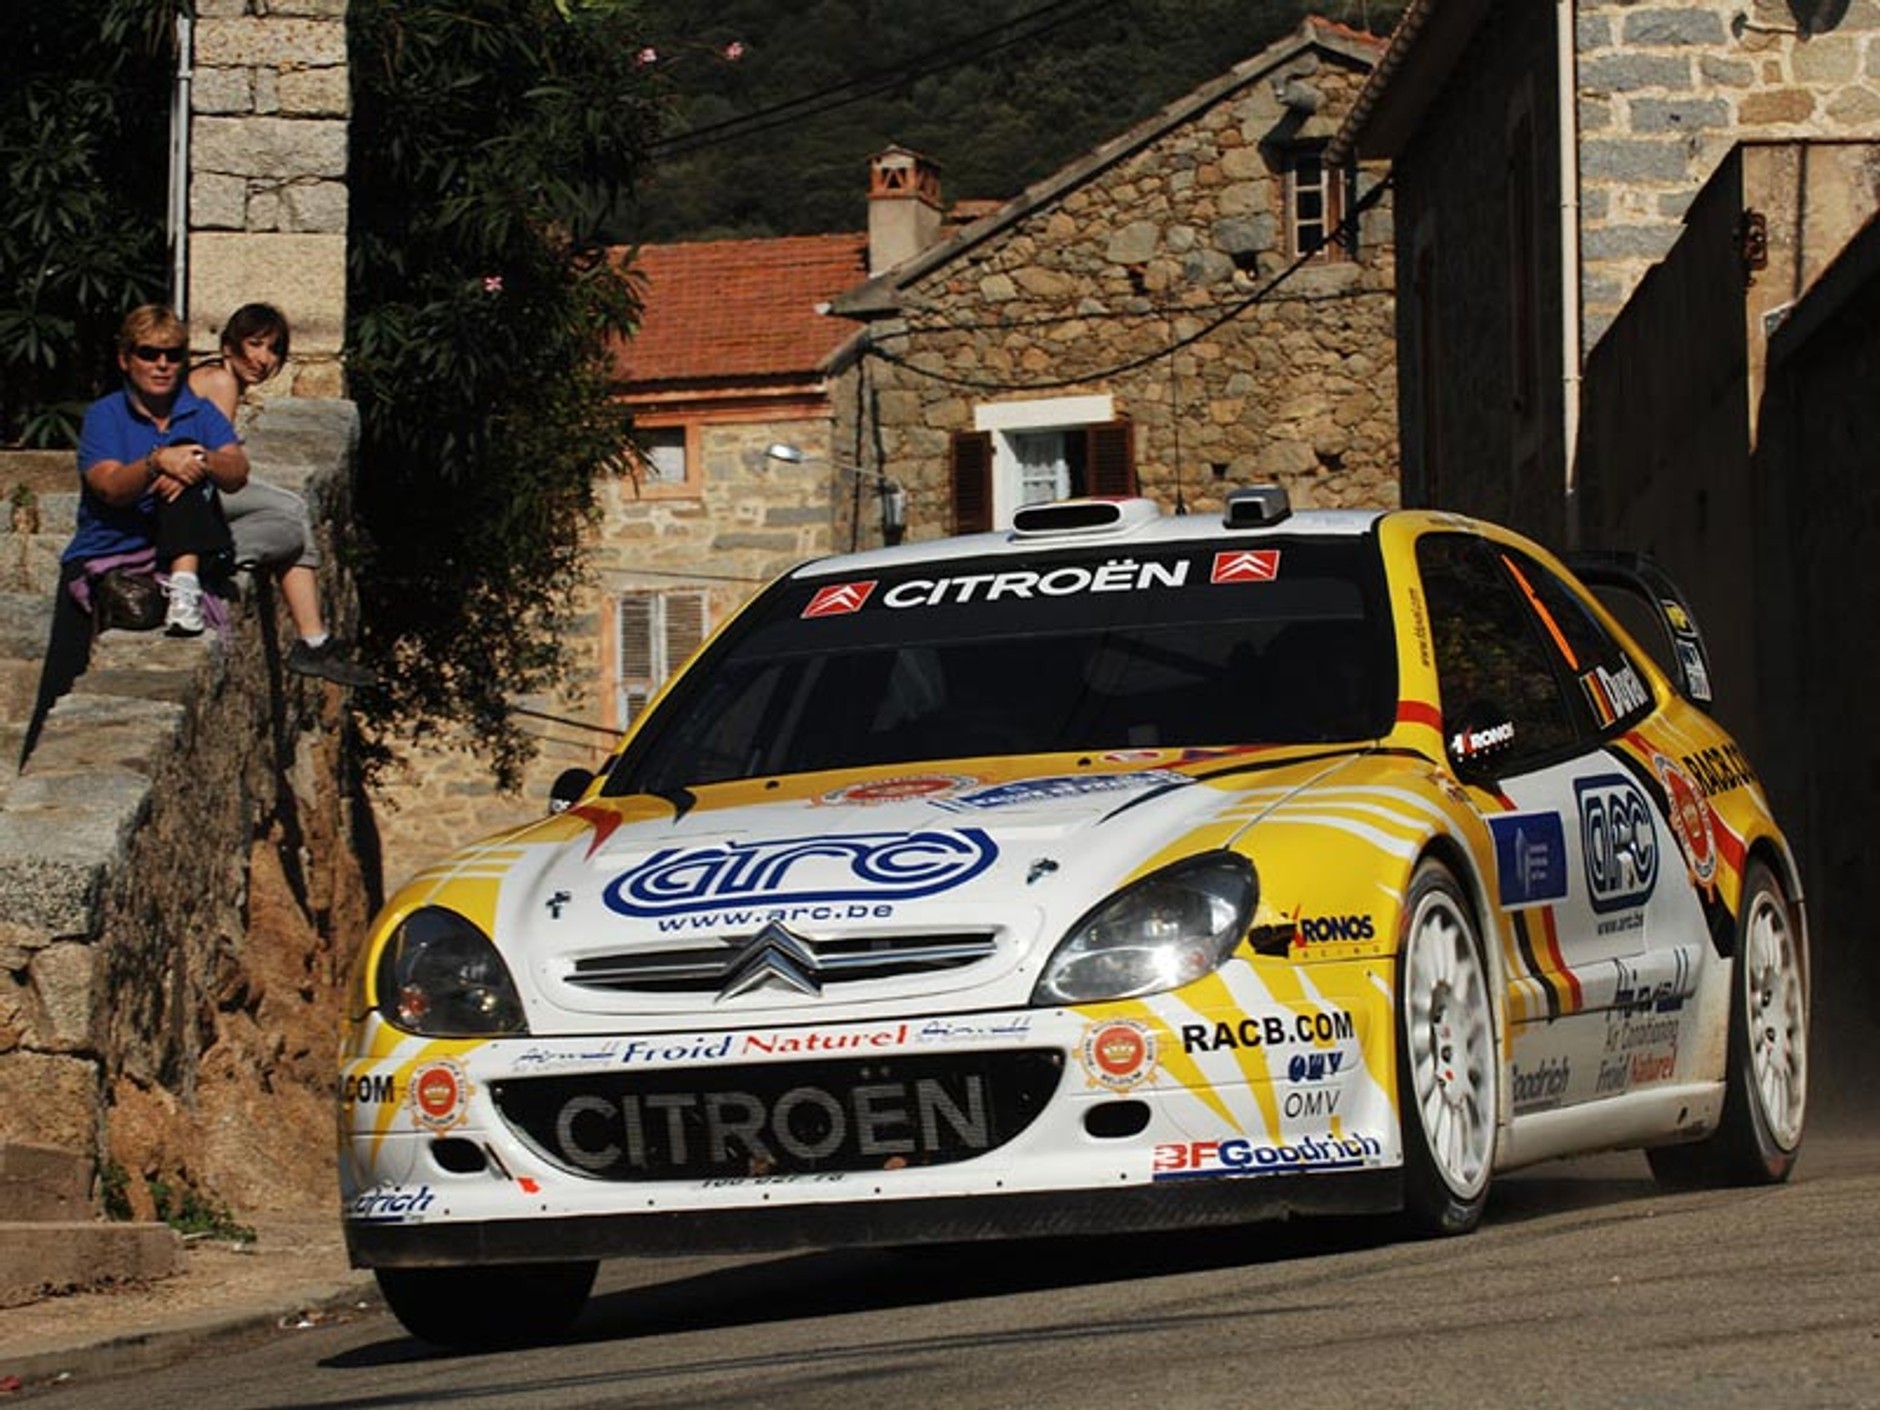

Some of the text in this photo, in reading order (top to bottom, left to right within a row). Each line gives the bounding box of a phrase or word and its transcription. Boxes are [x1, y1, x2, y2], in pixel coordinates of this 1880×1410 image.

[883, 559, 1190, 608] CITROËN
[658, 904, 894, 932] www.arc.be
[622, 1035, 733, 1064] Froid
[741, 1024, 909, 1056] Naturel
[1182, 1011, 1354, 1054] RACB.COM
[556, 1069, 990, 1172] CITROËN
[1284, 1091, 1340, 1118] OMV
[1154, 1134, 1381, 1171] BFGoodrich
